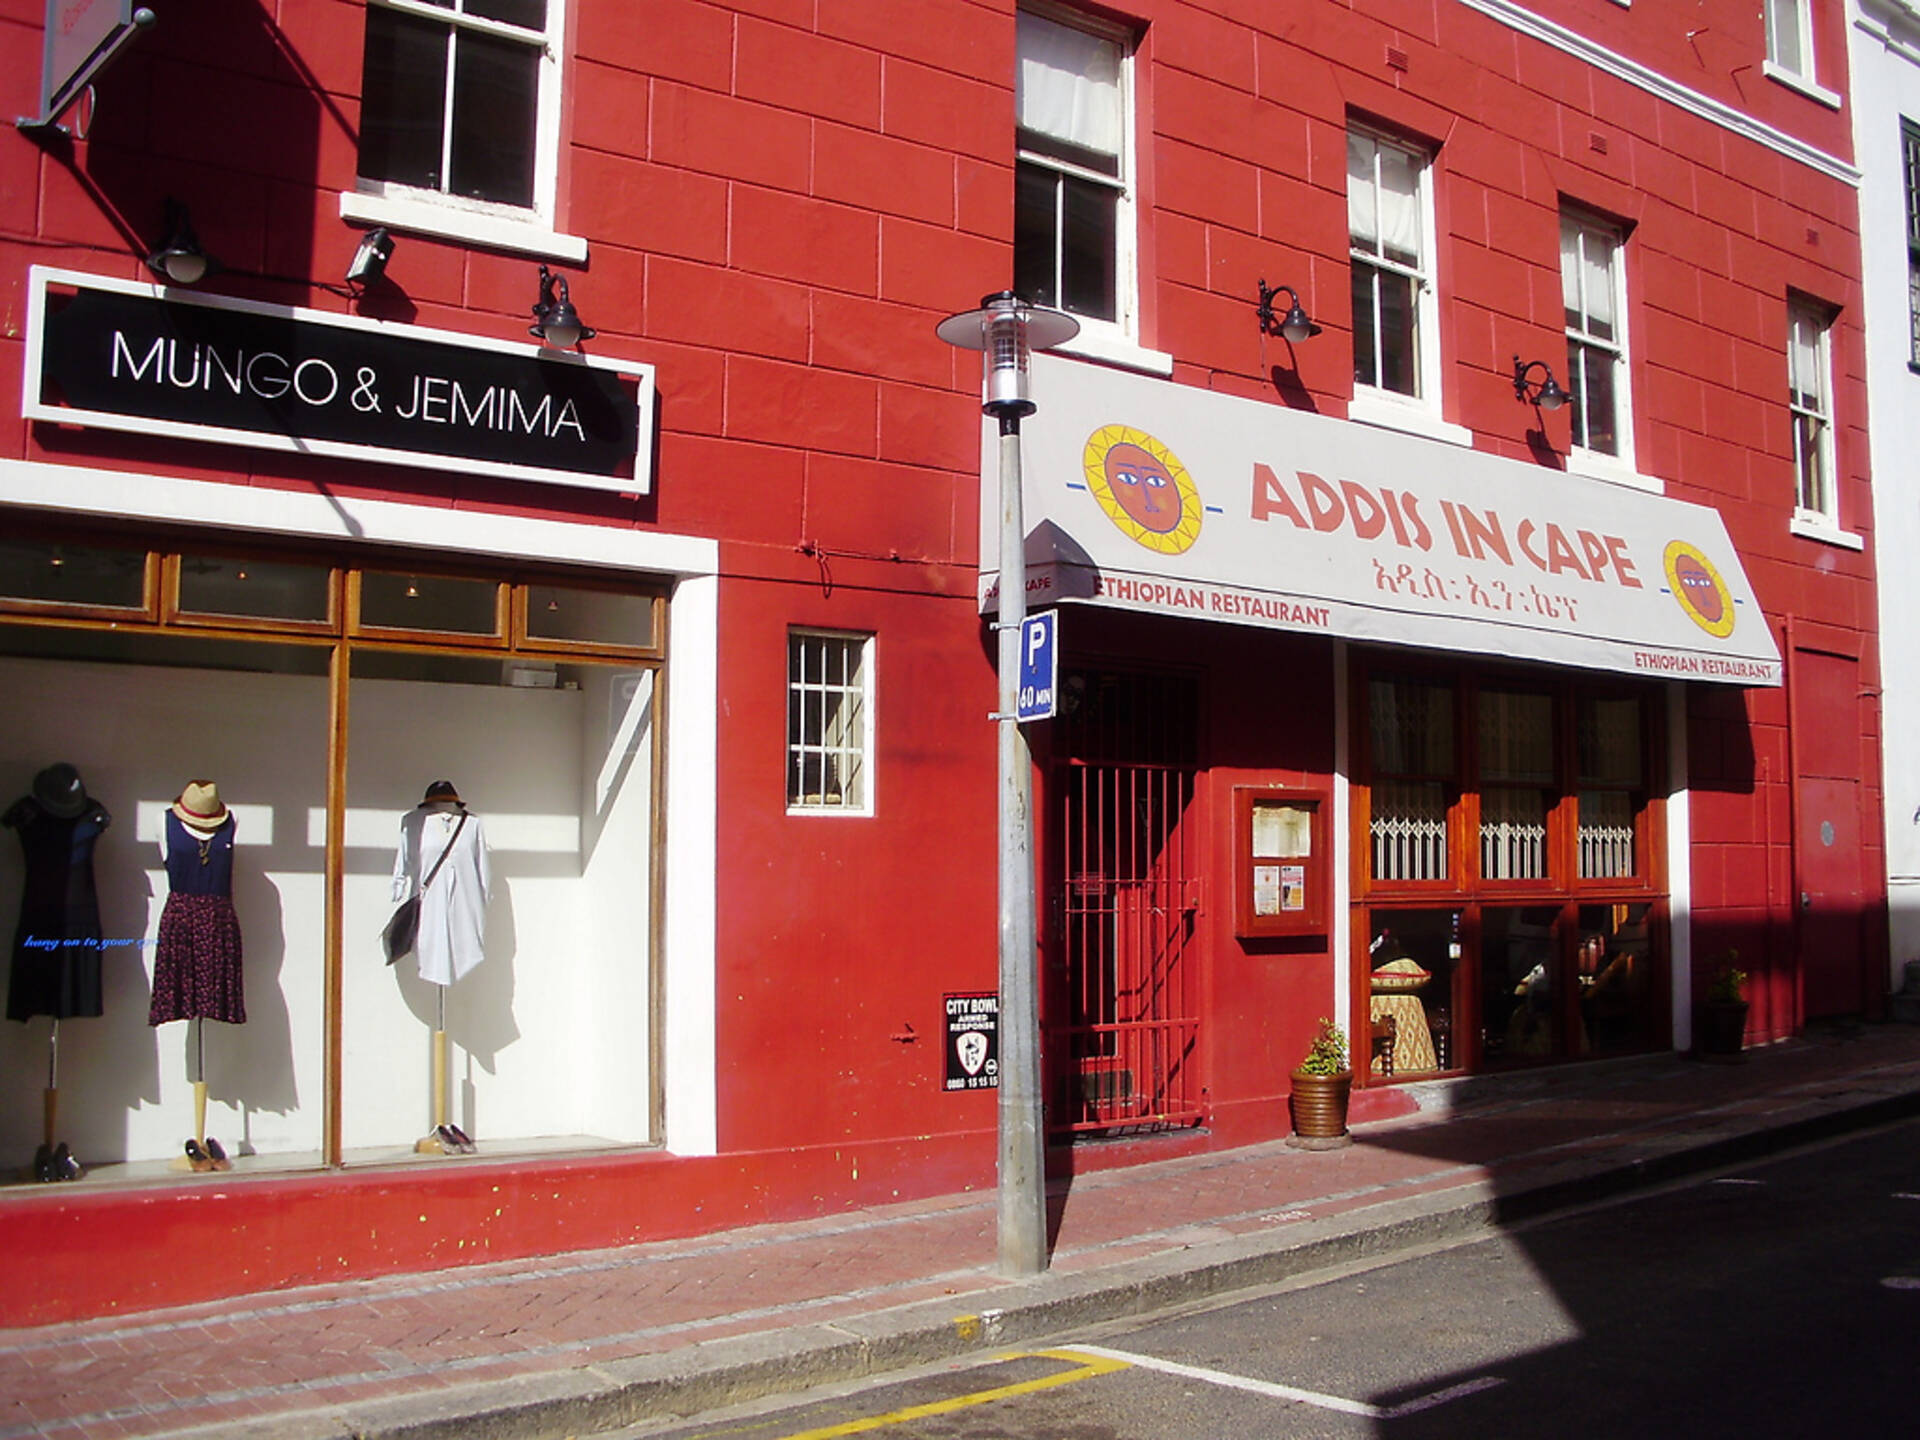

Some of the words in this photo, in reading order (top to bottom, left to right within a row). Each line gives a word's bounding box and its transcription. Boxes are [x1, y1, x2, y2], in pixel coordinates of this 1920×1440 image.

[110, 329, 339, 406] MUNGO
[349, 366, 383, 413] &
[394, 375, 587, 442] JEMIMA
[1250, 461, 1434, 553] ADDIS
[1438, 499, 1515, 567] IN
[1516, 517, 1644, 589] CAPE
[1093, 575, 1206, 611] ETHIOPIAN
[1210, 592, 1330, 627] RESTAURANT
[1028, 621, 1047, 667] P
[1634, 652, 1698, 672] ETHIOPIAN
[1701, 659, 1773, 679] RESTAURANT
[1020, 686, 1034, 709] 60
[1036, 688, 1051, 704] MIN
[24, 936, 60, 951] hang
[63, 939, 80, 947] on
[946, 998, 970, 1015] CITY
[971, 998, 999, 1014] BOWL
